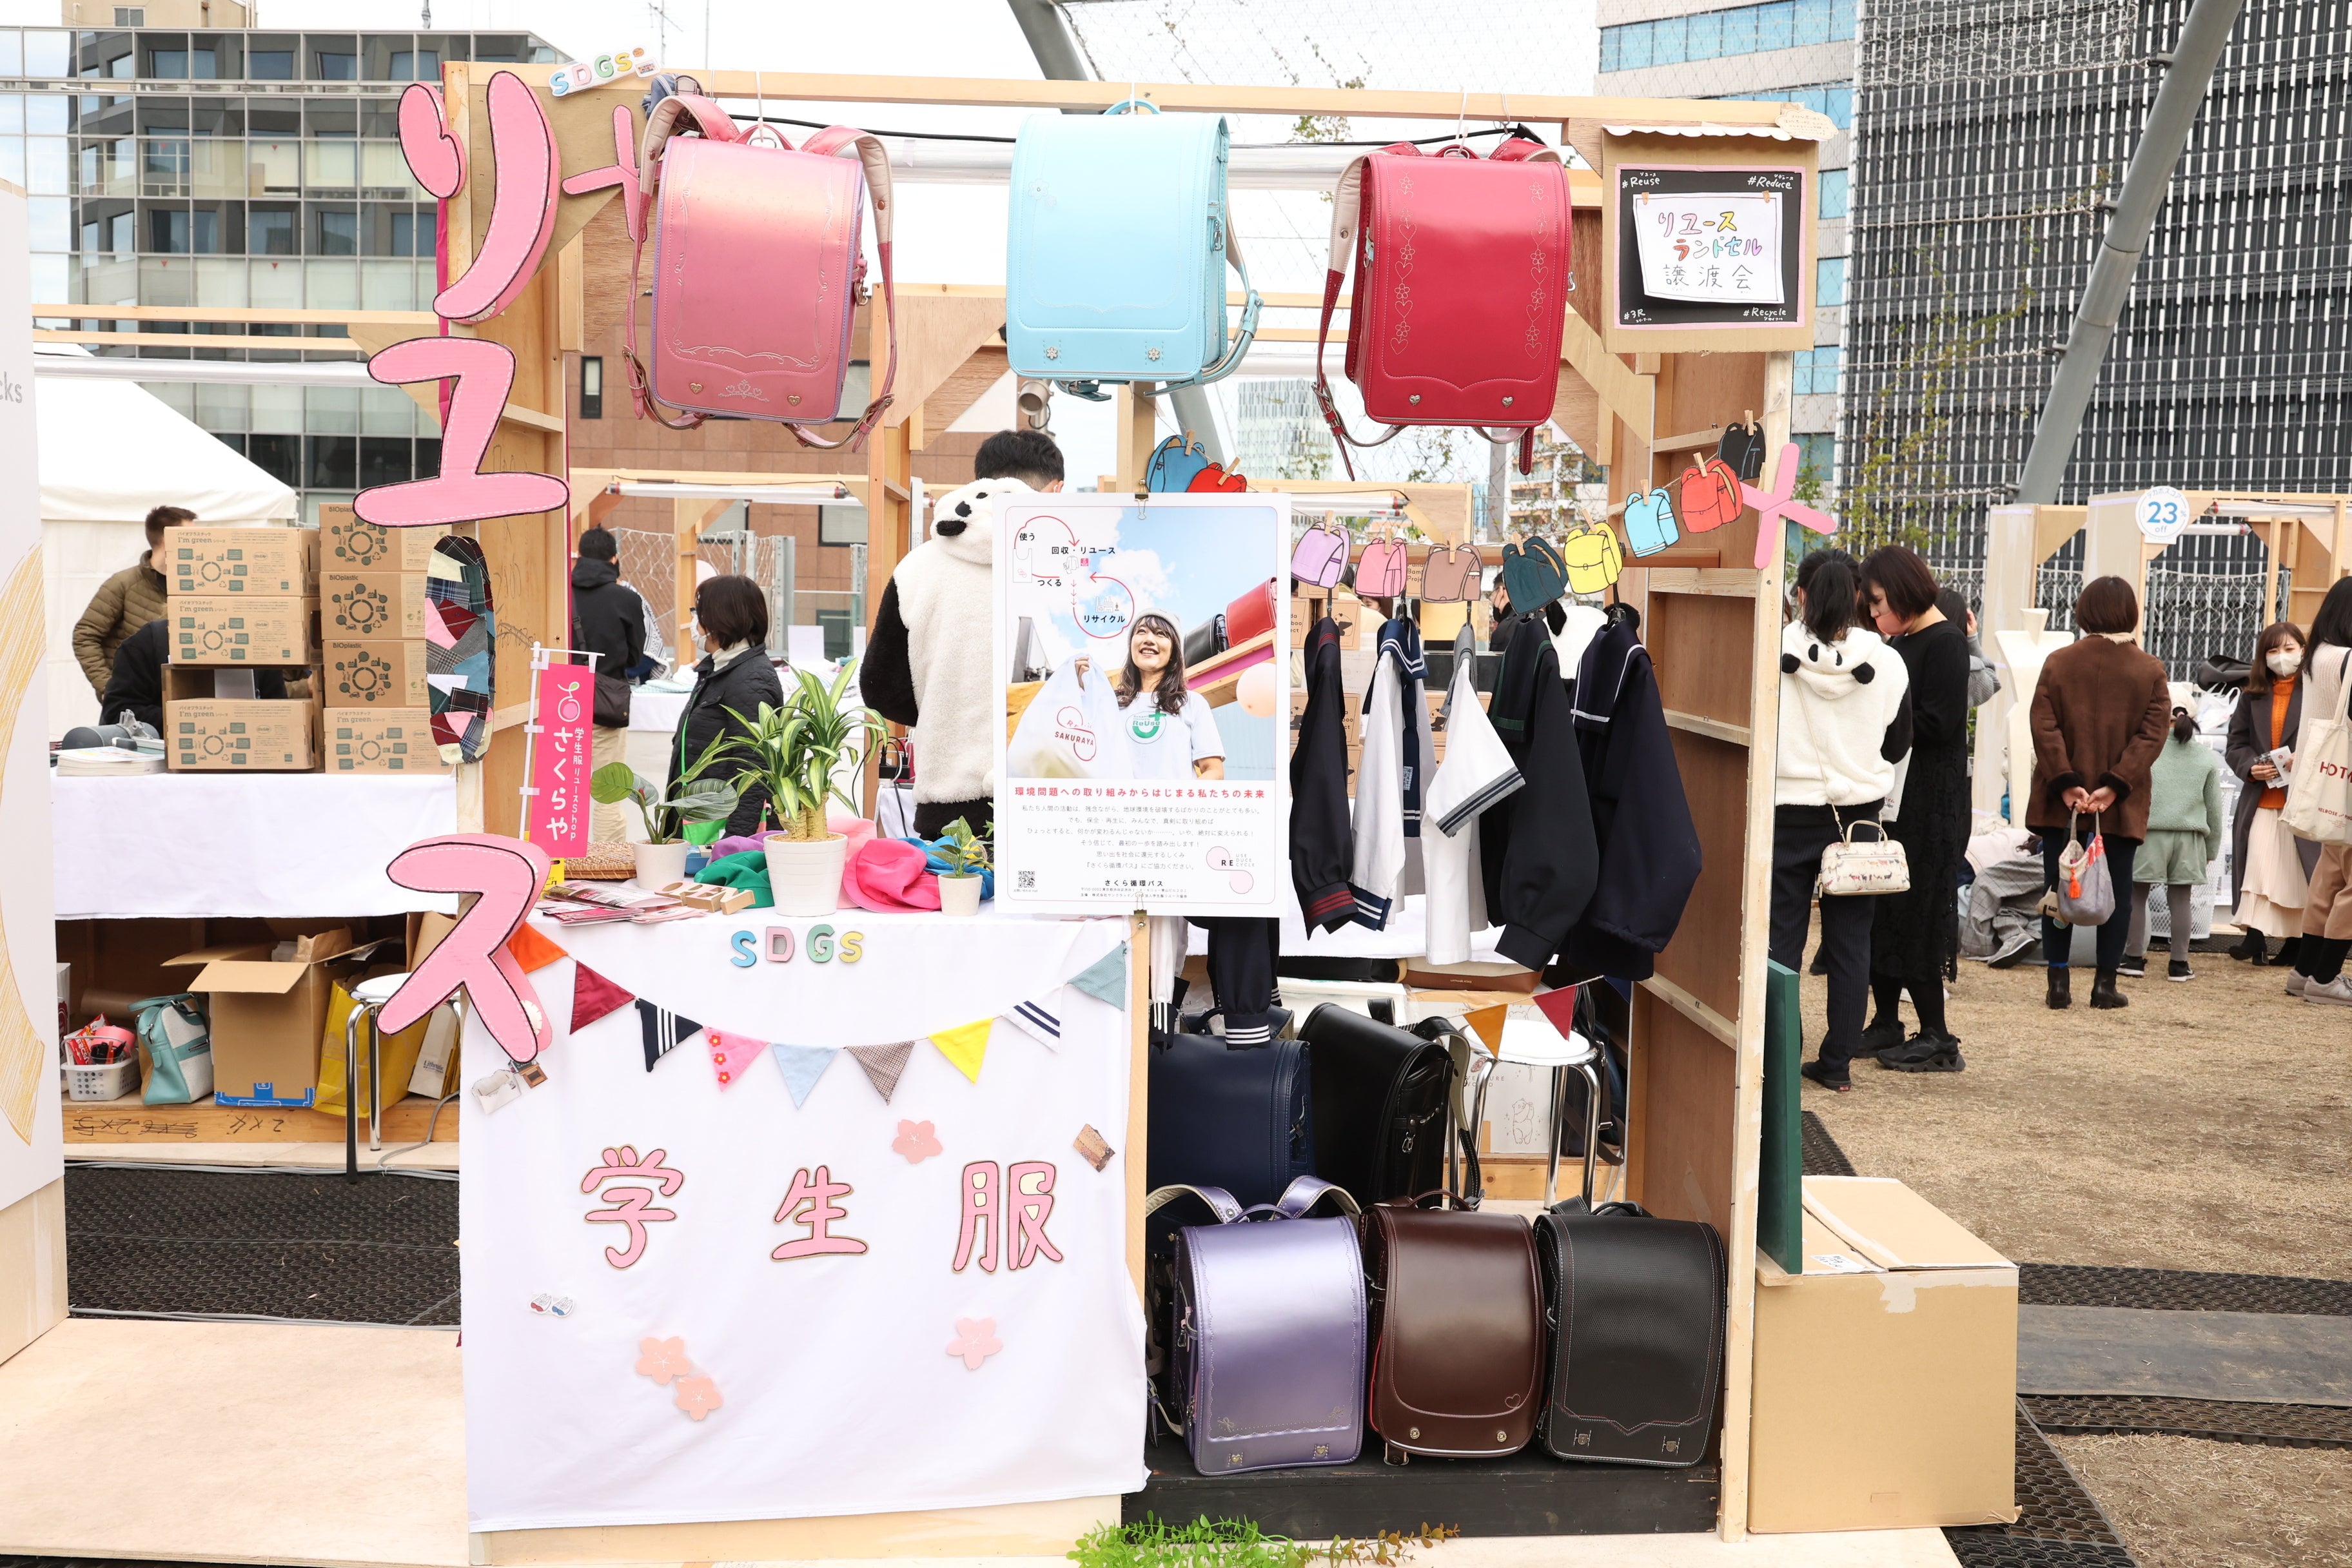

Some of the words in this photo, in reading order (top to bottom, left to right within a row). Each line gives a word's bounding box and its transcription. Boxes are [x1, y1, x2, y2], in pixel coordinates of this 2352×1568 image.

[550, 52, 633, 95] SDGS
[1658, 211, 1737, 237] リユース
[1673, 236, 1763, 261] ランドセル
[1663, 264, 1753, 290] 譲渡会
[0, 371, 23, 404] ks
[2147, 501, 2178, 524] 23
[1019, 533, 1035, 541] 使う
[1052, 546, 1115, 554] 回収・リユース
[1055, 731, 1093, 746] SAKURAYA
[546, 726, 574, 841] さくらや
[1015, 786, 1265, 799] 環境問題への取り組みからはじまる私たちの未来
[654, 881, 756, 916] OPEN
[730, 923, 865, 968] SDGS
[580, 1144, 1064, 1275] 学生服
